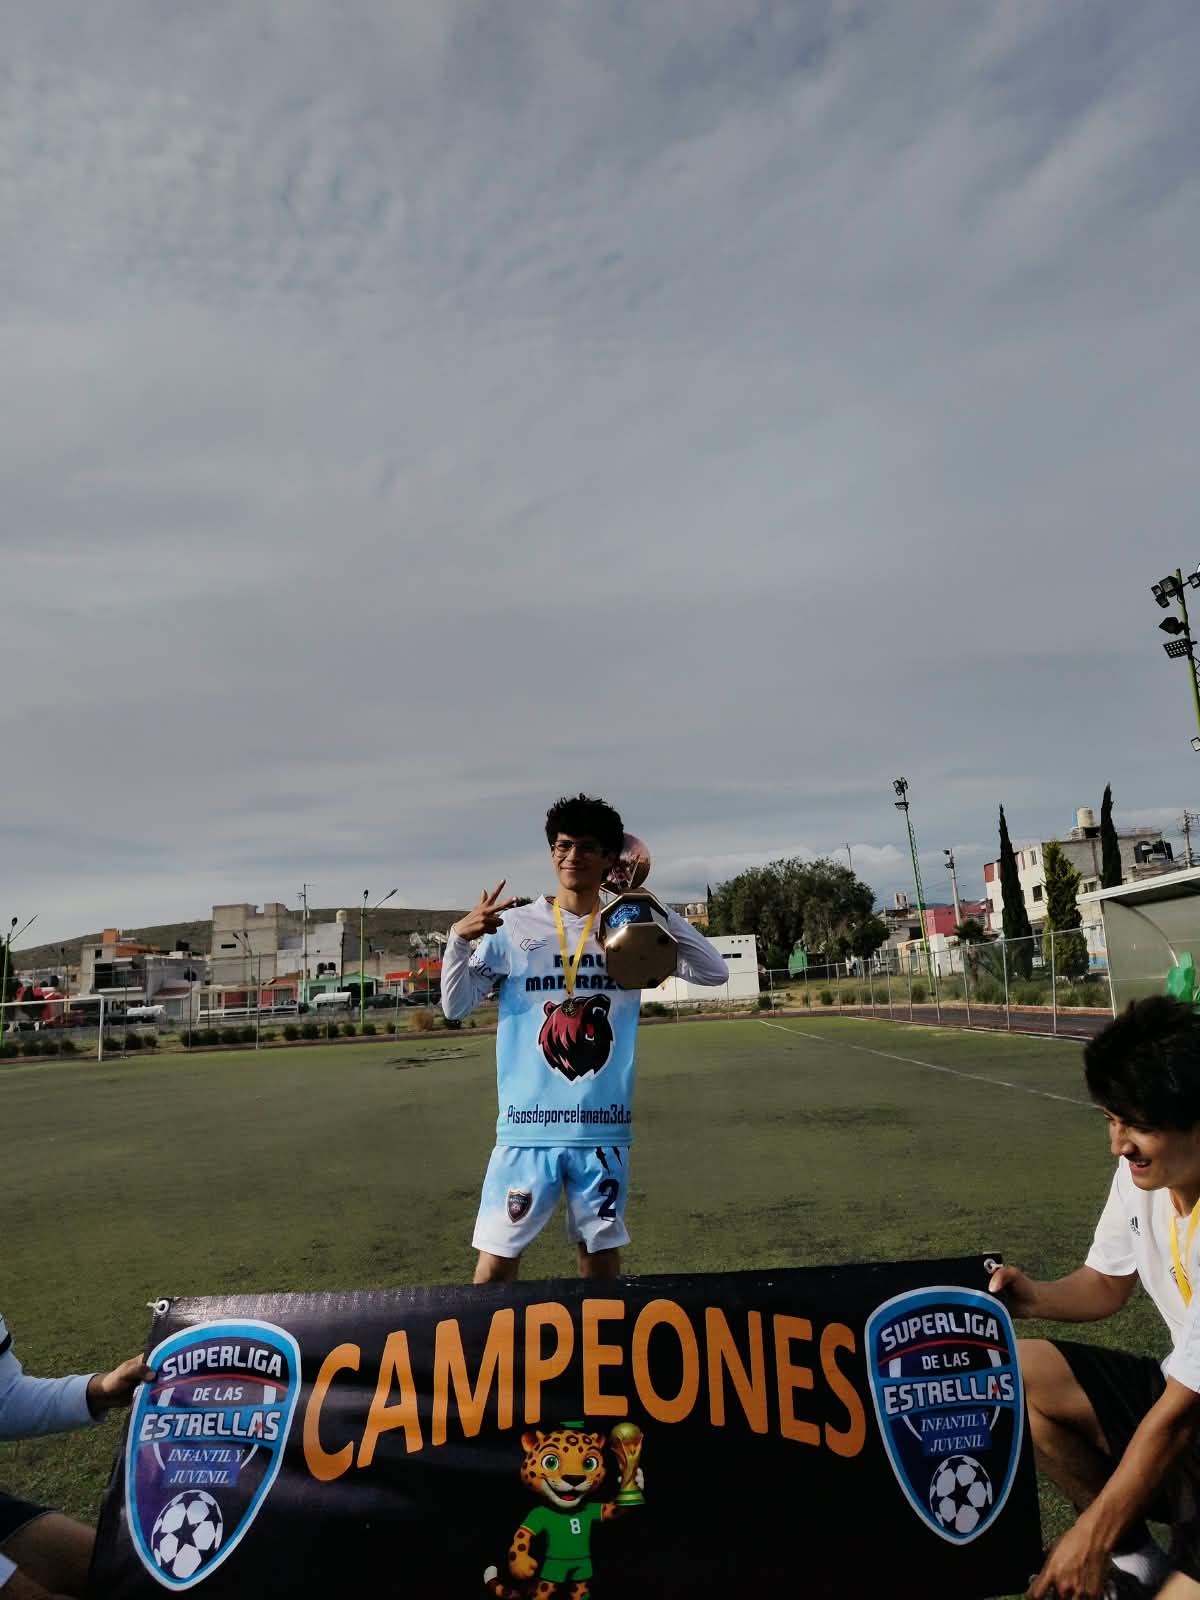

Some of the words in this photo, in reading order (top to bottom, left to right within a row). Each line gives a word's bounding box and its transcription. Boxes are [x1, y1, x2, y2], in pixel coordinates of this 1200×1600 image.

[597, 1178, 620, 1222] 2
[881, 1311, 999, 1352] SUPERLIGA
[161, 1345, 282, 1381] SUPERLIGA
[921, 1355, 941, 1371] DE
[942, 1352, 970, 1367] LAS
[192, 1387, 213, 1401] DE
[214, 1386, 244, 1401] LAS
[302, 1298, 867, 1482] CAMPEONES
[883, 1373, 1015, 1415] ESTRELLAS
[140, 1411, 281, 1442] ESTRELLAS
[920, 1414, 979, 1432] INFANTIL
[981, 1411, 989, 1425] Y
[930, 1435, 985, 1453] JUVENIL
[167, 1448, 232, 1462] INFANTIL
[234, 1448, 245, 1462] Y
[169, 1469, 230, 1484] JUVENIL
[569, 1518, 581, 1535] 8
